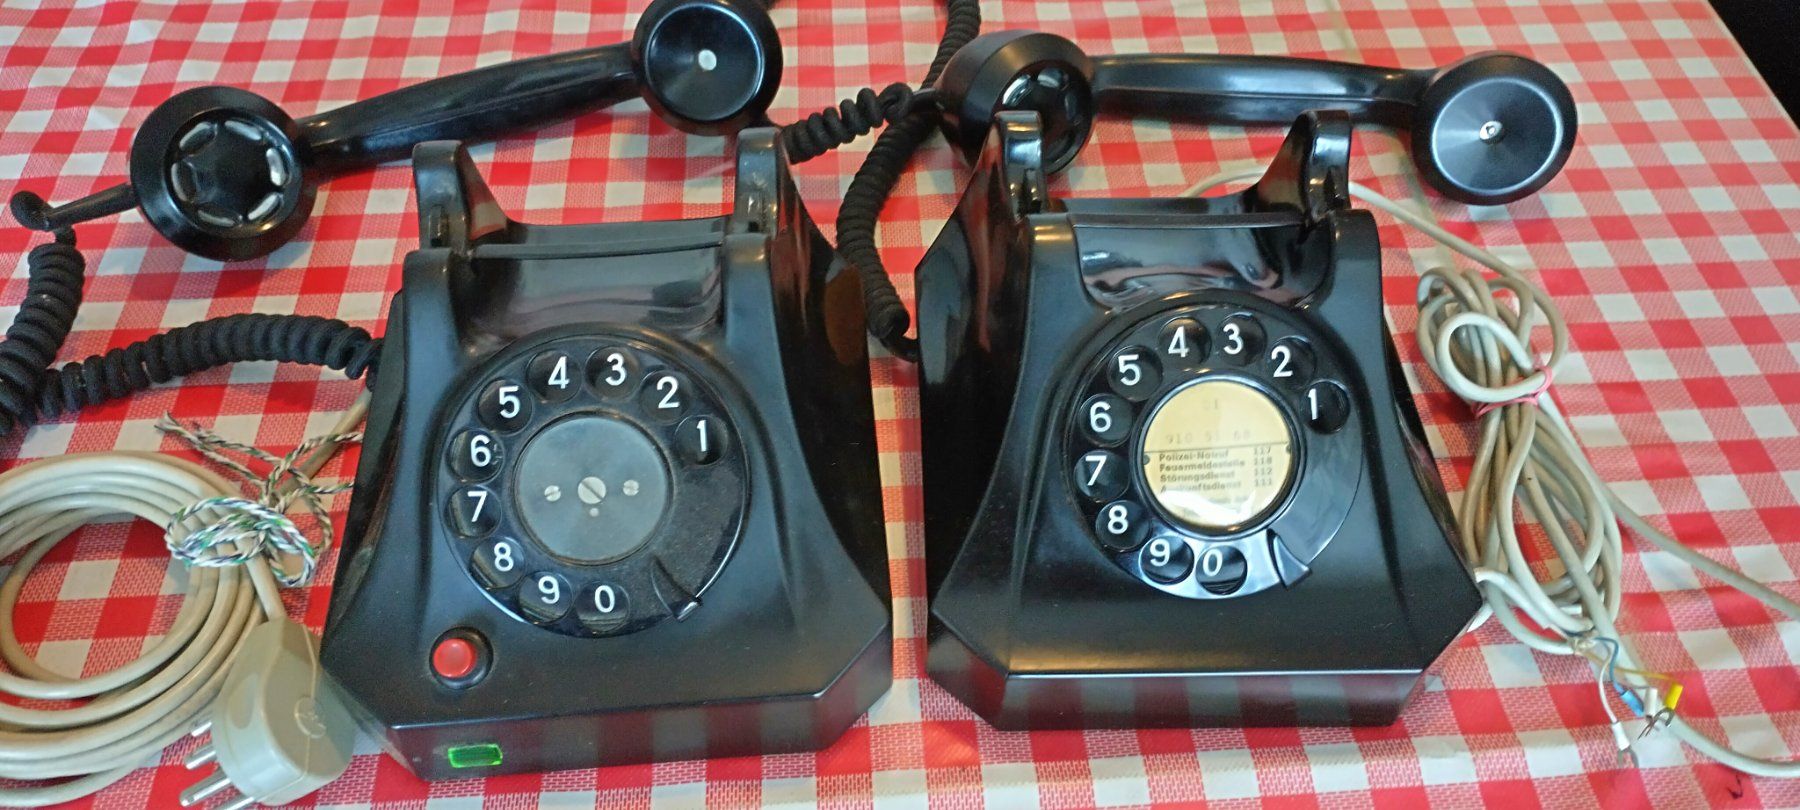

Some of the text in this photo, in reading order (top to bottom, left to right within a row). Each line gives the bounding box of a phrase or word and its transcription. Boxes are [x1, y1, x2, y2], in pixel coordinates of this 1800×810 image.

[1168, 326, 1188, 357] 4
[1223, 323, 1243, 355] 3
[548, 356, 569, 388] 4
[606, 353, 626, 385] 3
[1118, 355, 1140, 385] 5
[1272, 346, 1292, 377] 2
[499, 386, 520, 418] 5
[657, 376, 679, 408] 2
[1308, 389, 1317, 419] 1
[1090, 402, 1111, 432] 6
[471, 435, 491, 466] 6
[697, 420, 706, 451] 1
[1086, 455, 1106, 485] 7
[468, 491, 487, 522] 7
[1108, 505, 1128, 534] 8
[494, 542, 513, 571] 8
[1150, 540, 1171, 567] 9
[1202, 548, 1223, 577] 0
[539, 576, 559, 603] 9
[595, 585, 615, 612] 0
